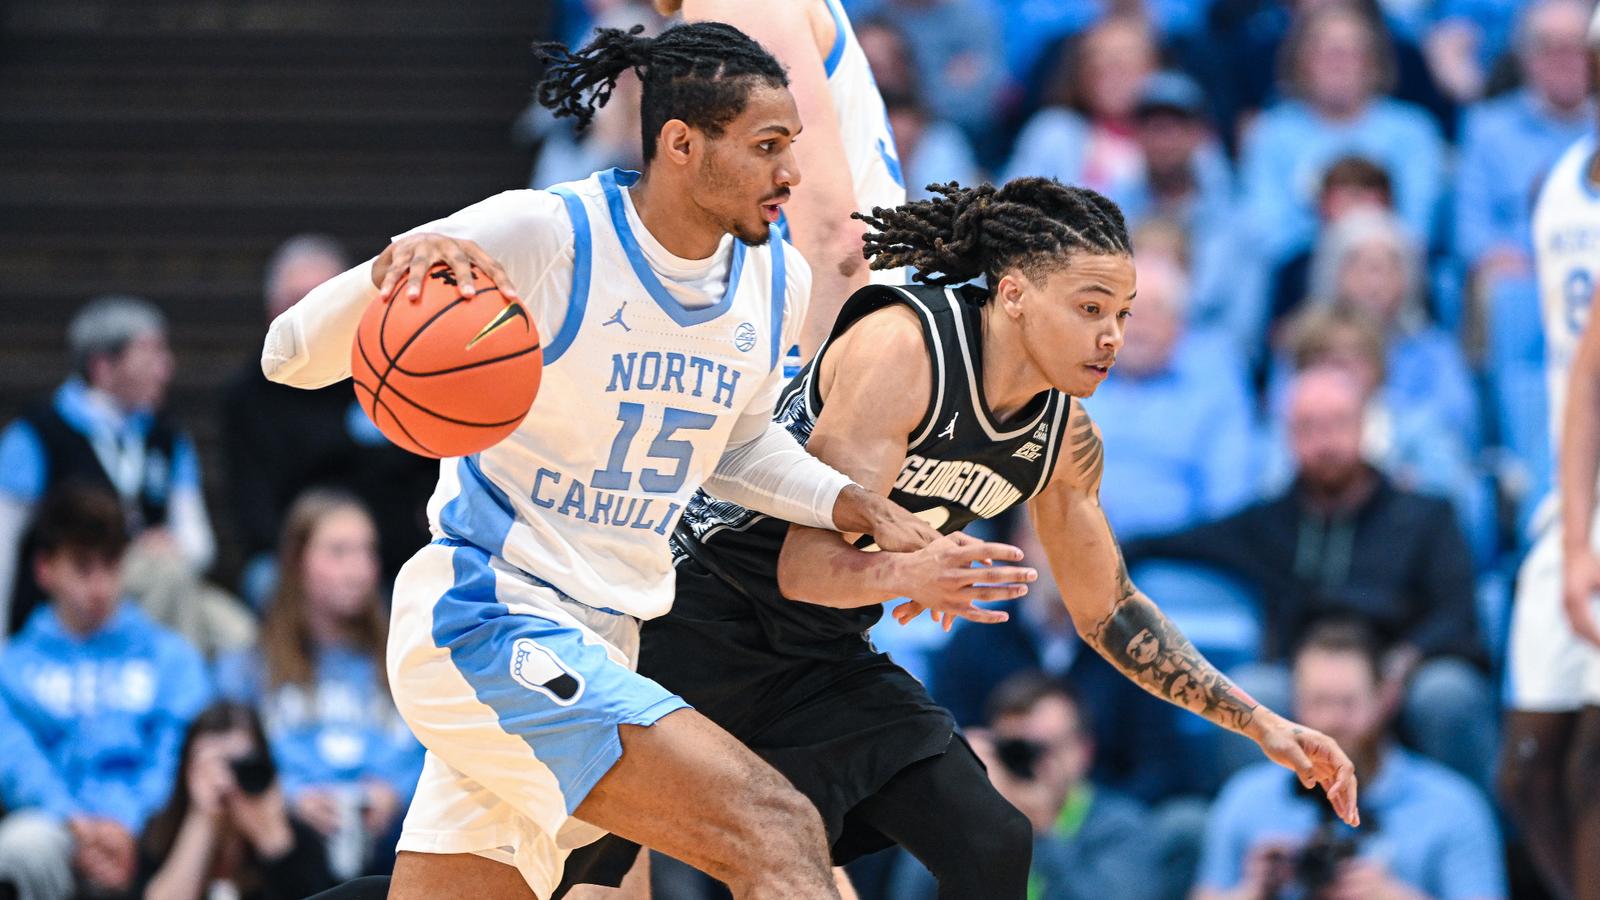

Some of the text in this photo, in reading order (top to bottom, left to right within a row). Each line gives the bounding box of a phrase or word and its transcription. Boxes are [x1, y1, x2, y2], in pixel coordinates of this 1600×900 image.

[605, 351, 741, 409] NORTH
[590, 401, 718, 494] 15
[1014, 448, 1042, 460] EAST
[1022, 441, 1043, 452] BIG
[893, 453, 1023, 520] GEORGETOWN
